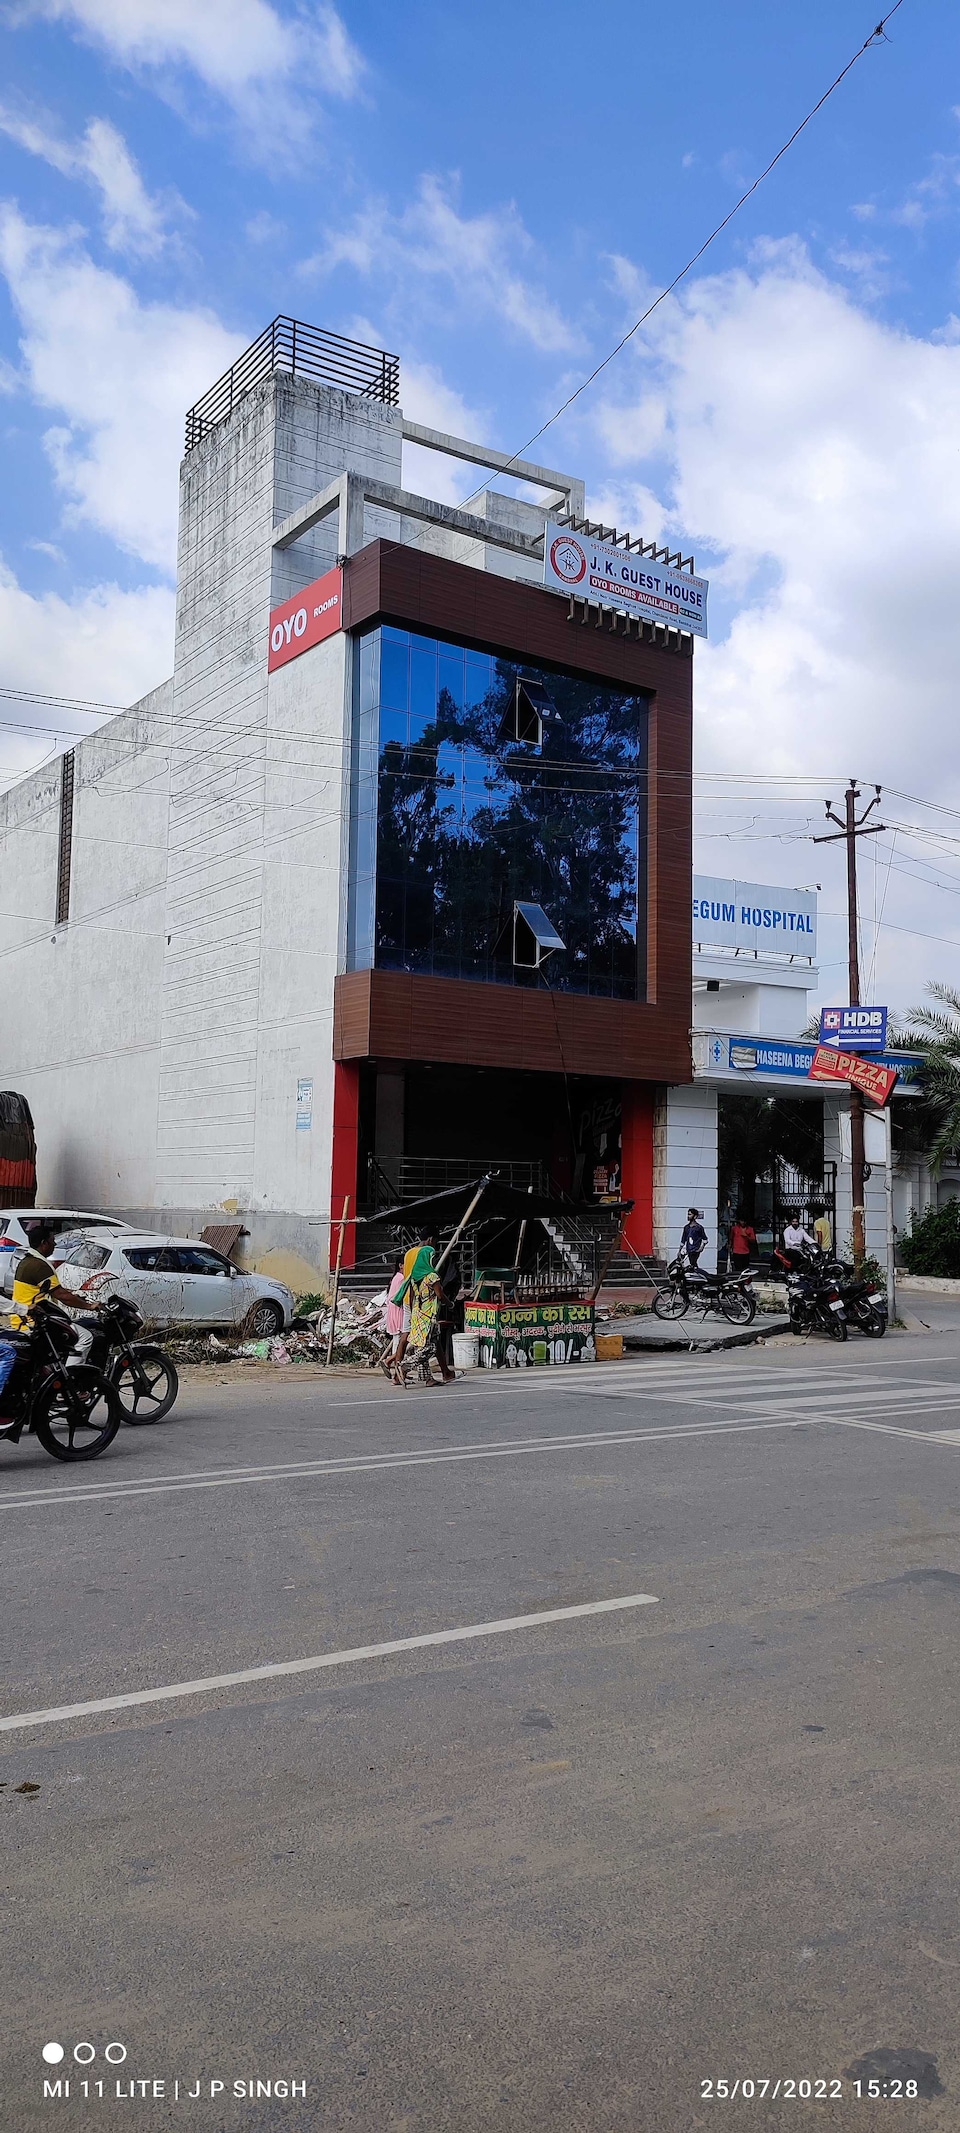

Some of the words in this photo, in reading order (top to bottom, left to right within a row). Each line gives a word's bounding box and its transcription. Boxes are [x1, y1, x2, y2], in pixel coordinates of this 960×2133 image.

[590, 556, 601, 572] J.
[605, 560, 617, 577] K.
[621, 566, 661, 592] GUEST
[664, 581, 703, 608] HOUSE
[591, 577, 608, 590] OYO
[609, 583, 637, 600] ROOMS
[637, 592, 678, 614] AVAILABLE
[313, 594, 339, 618] ROOMS
[271, 608, 307, 652] OYO
[741, 906, 814, 933] HOSPITAL
[843, 1011, 882, 1027] HDB
[756, 1049, 793, 1068] HASEENA
[837, 1055, 888, 1088] PIZZA
[541, 1306, 564, 1322] का
[567, 1304, 591, 1321] रस
